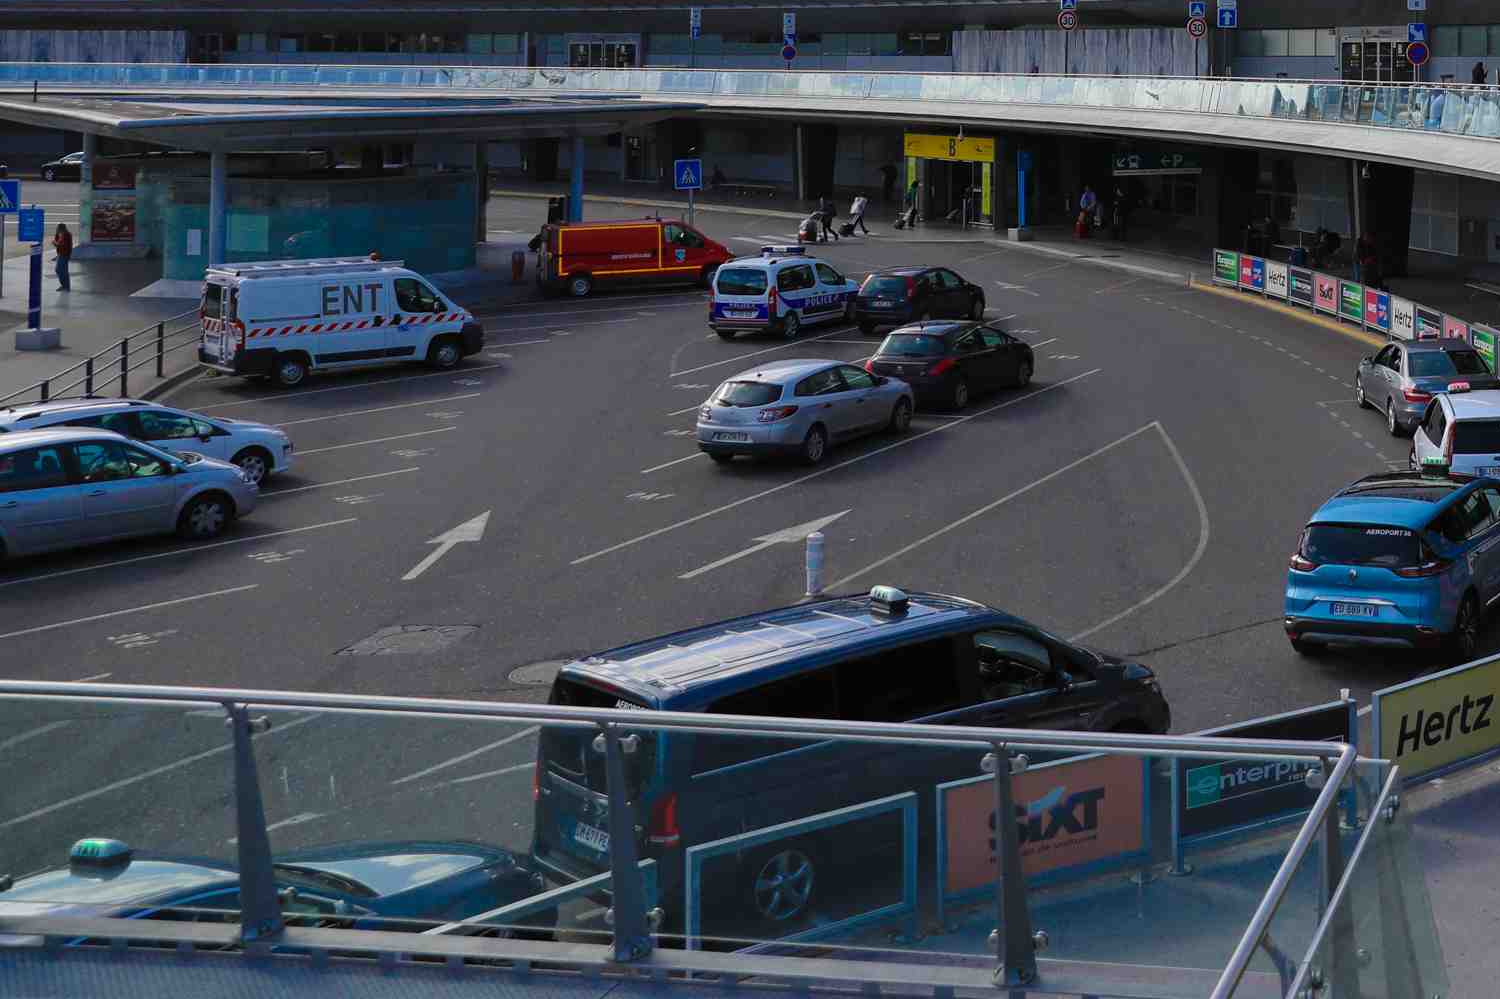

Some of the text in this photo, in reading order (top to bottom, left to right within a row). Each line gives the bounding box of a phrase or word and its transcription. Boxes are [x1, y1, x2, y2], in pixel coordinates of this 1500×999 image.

[1062, 16, 1073, 25] 30
[1191, 23, 1201, 32] 30
[1268, 271, 1286, 288] Hertz
[322, 283, 383, 315] ENT
[804, 295, 833, 306] POLICE
[1394, 308, 1412, 328] Hertz
[1396, 694, 1494, 757] Hertz
[1196, 758, 1322, 794] enterpri
